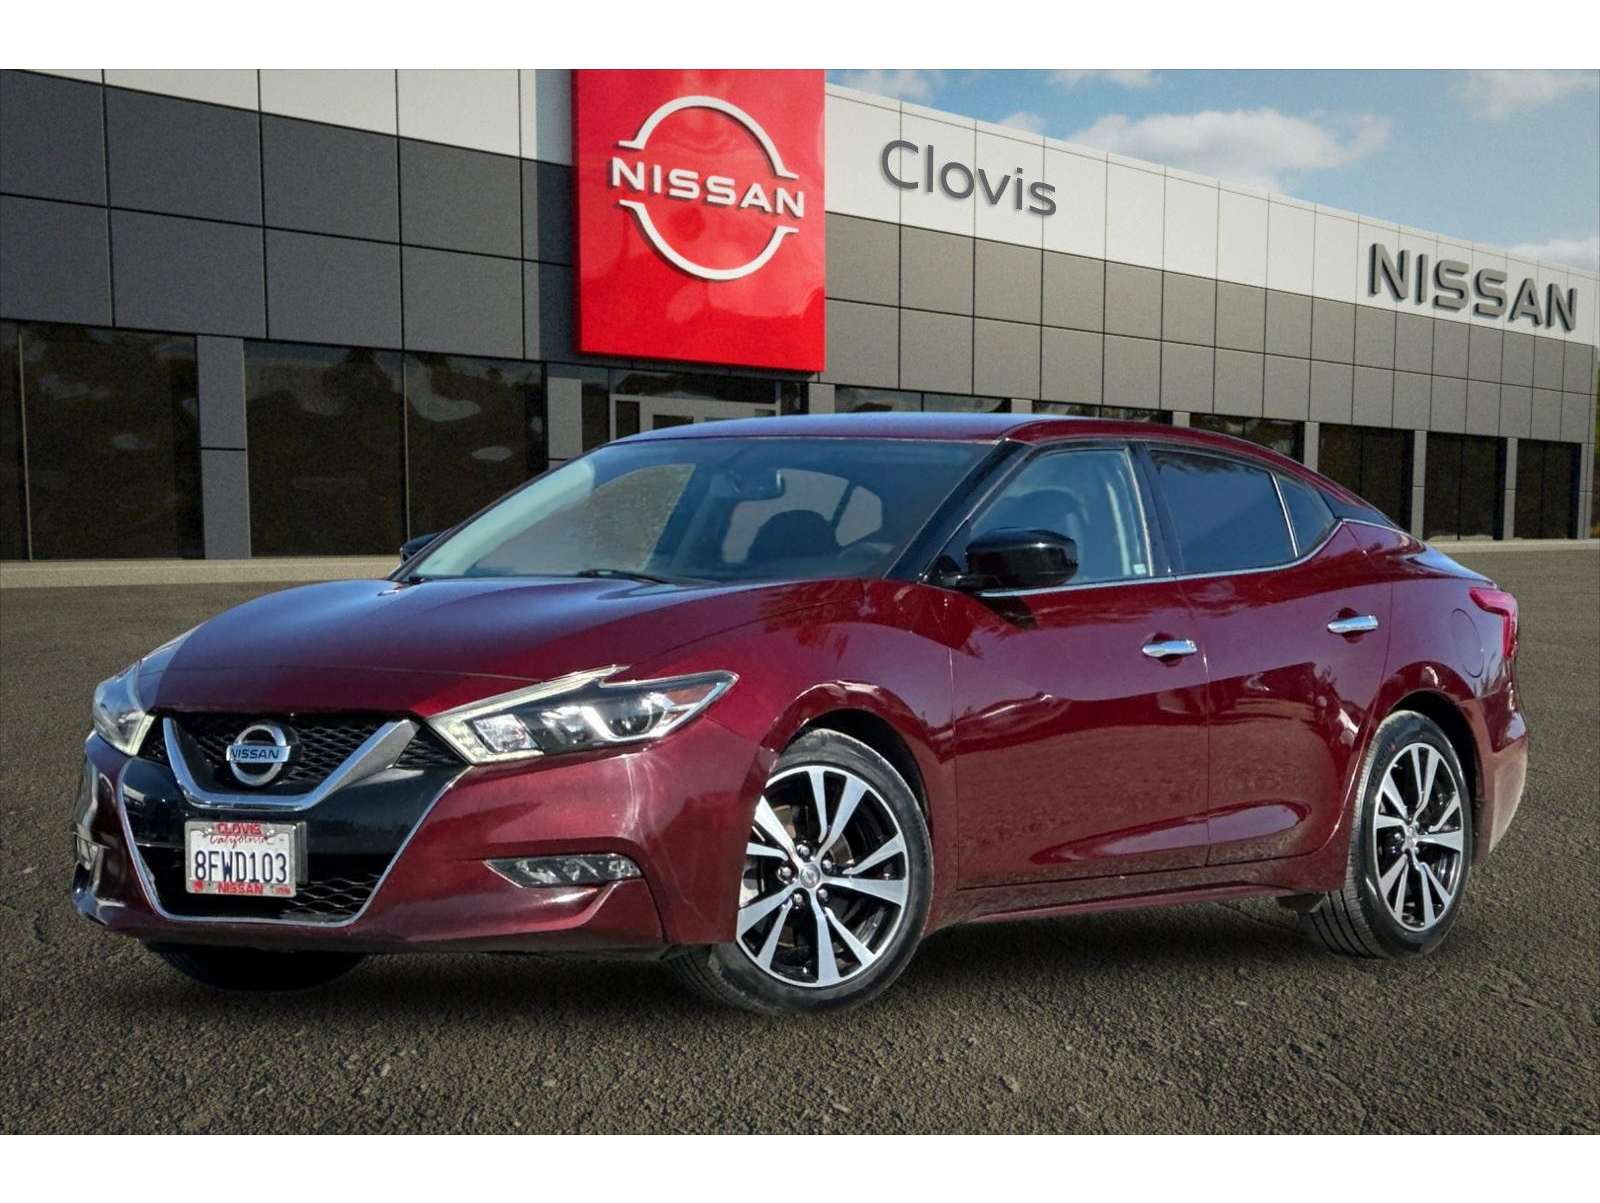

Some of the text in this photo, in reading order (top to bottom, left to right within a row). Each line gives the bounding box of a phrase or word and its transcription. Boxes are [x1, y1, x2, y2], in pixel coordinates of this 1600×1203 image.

[609, 156, 806, 219] NISSAN
[881, 139, 1058, 217] Clovis
[1368, 242, 1578, 333] NISSAN
[231, 748, 280, 760] NISSAN
[216, 822, 262, 835] CLOVIS
[194, 850, 288, 884] 8FWD103
[217, 881, 264, 895] NISSAN
